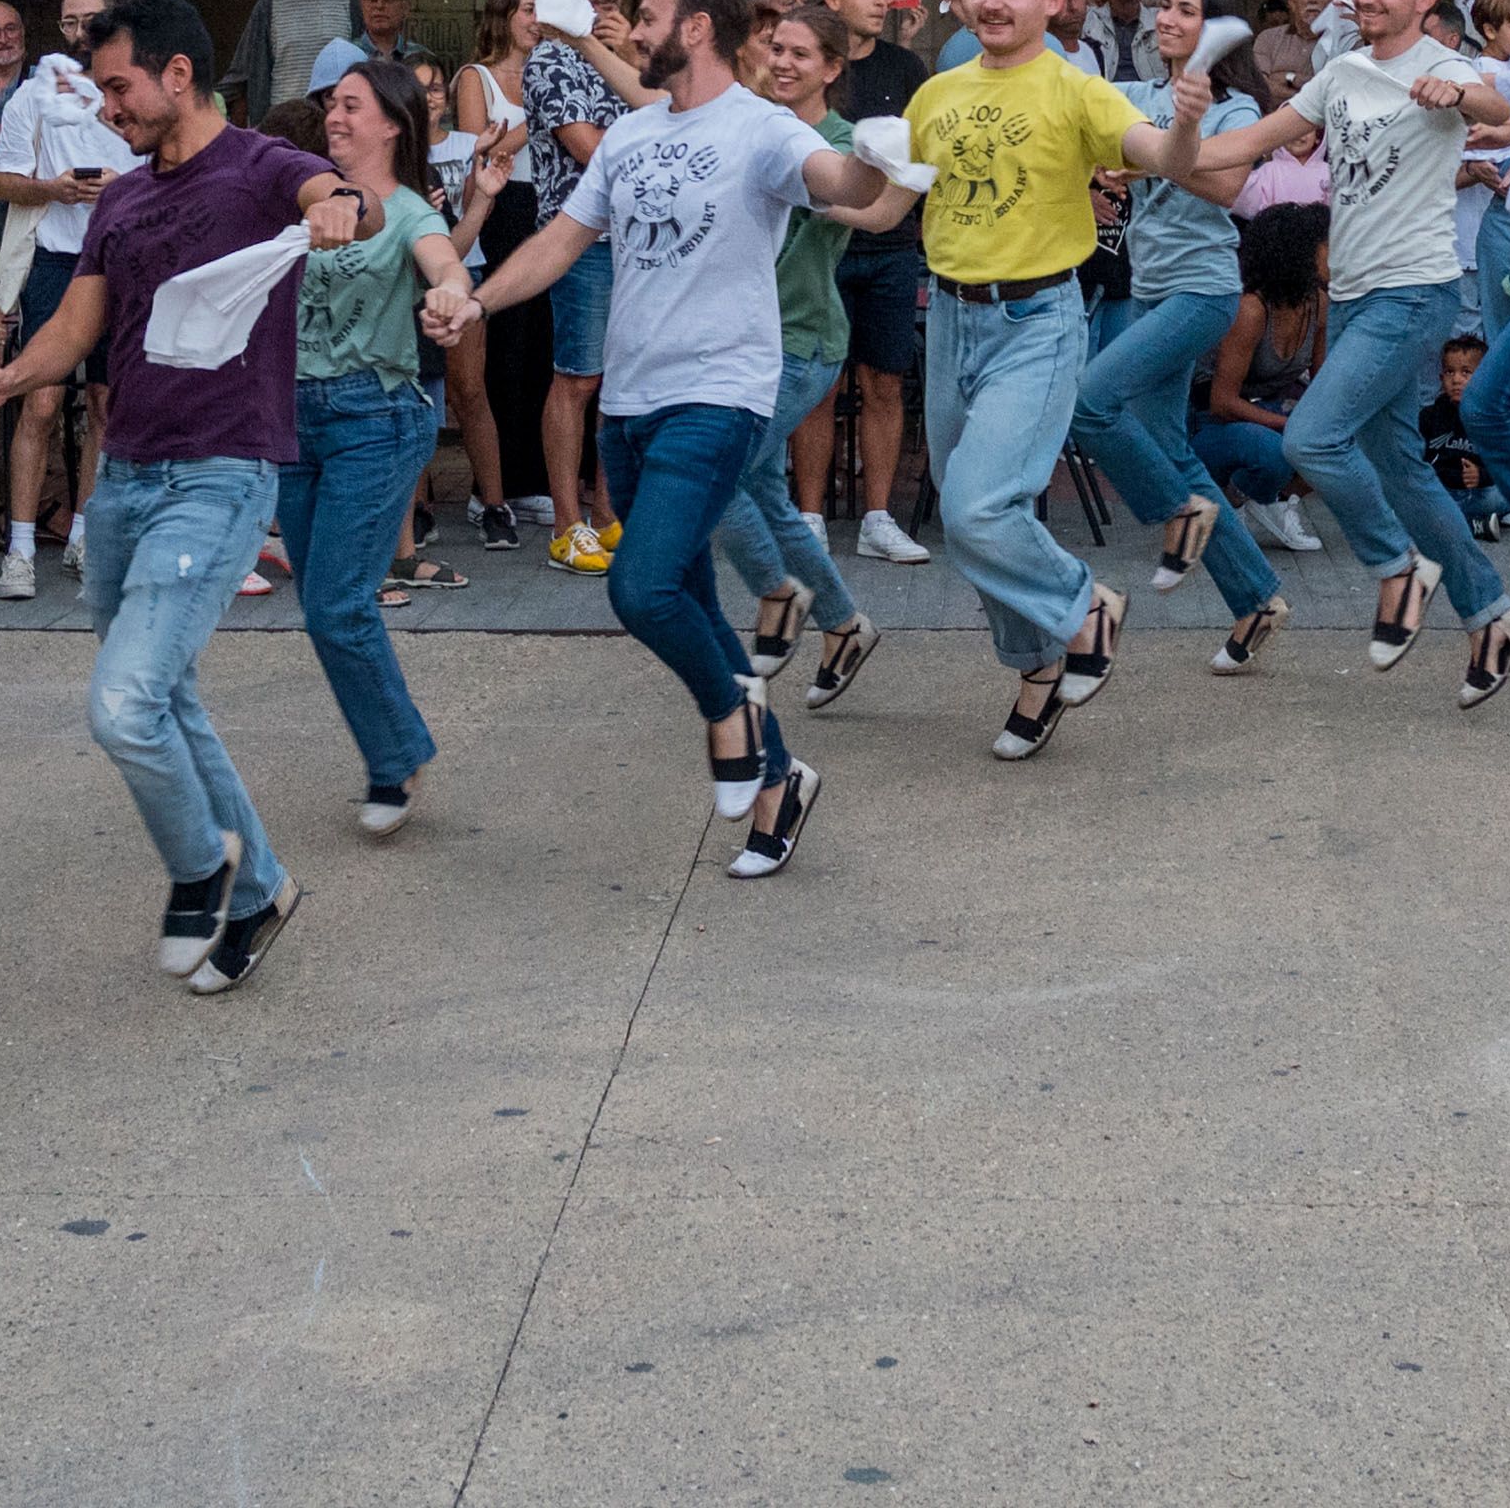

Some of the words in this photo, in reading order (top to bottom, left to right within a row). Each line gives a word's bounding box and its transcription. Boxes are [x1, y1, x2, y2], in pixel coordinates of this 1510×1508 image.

[966, 105, 1002, 122] 100
[651, 143, 688, 159] 100
[677, 201, 717, 258] ESBART
